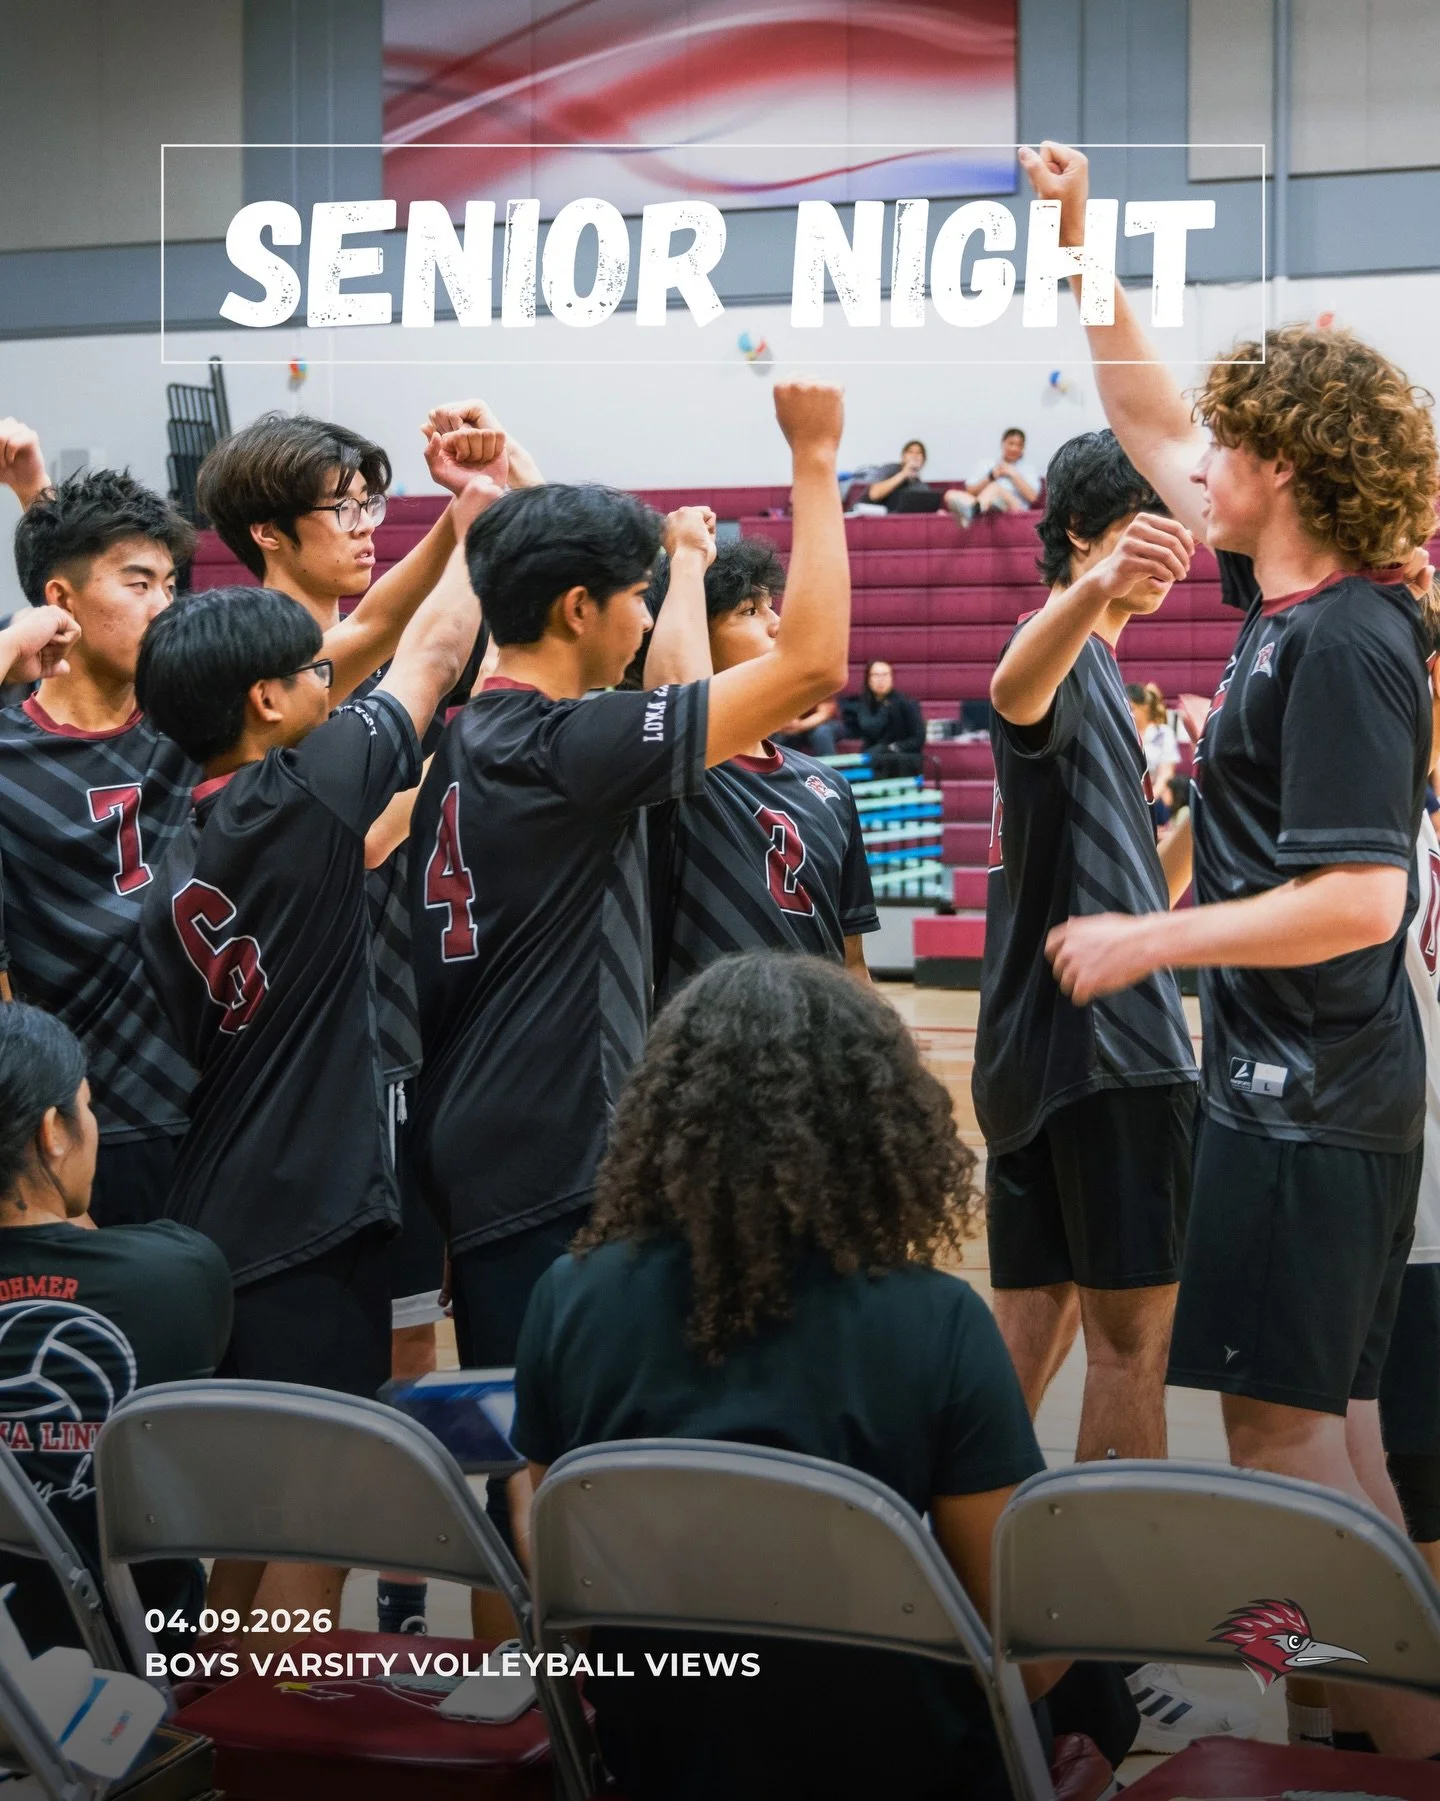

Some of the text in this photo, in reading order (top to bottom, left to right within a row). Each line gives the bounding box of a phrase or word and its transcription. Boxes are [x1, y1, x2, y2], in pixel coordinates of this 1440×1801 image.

[87, 783, 153, 896] 7
[425, 782, 479, 963] 4
[753, 804, 815, 917] 2
[172, 878, 269, 1034] 6
[1264, 1082, 1271, 1092] L
